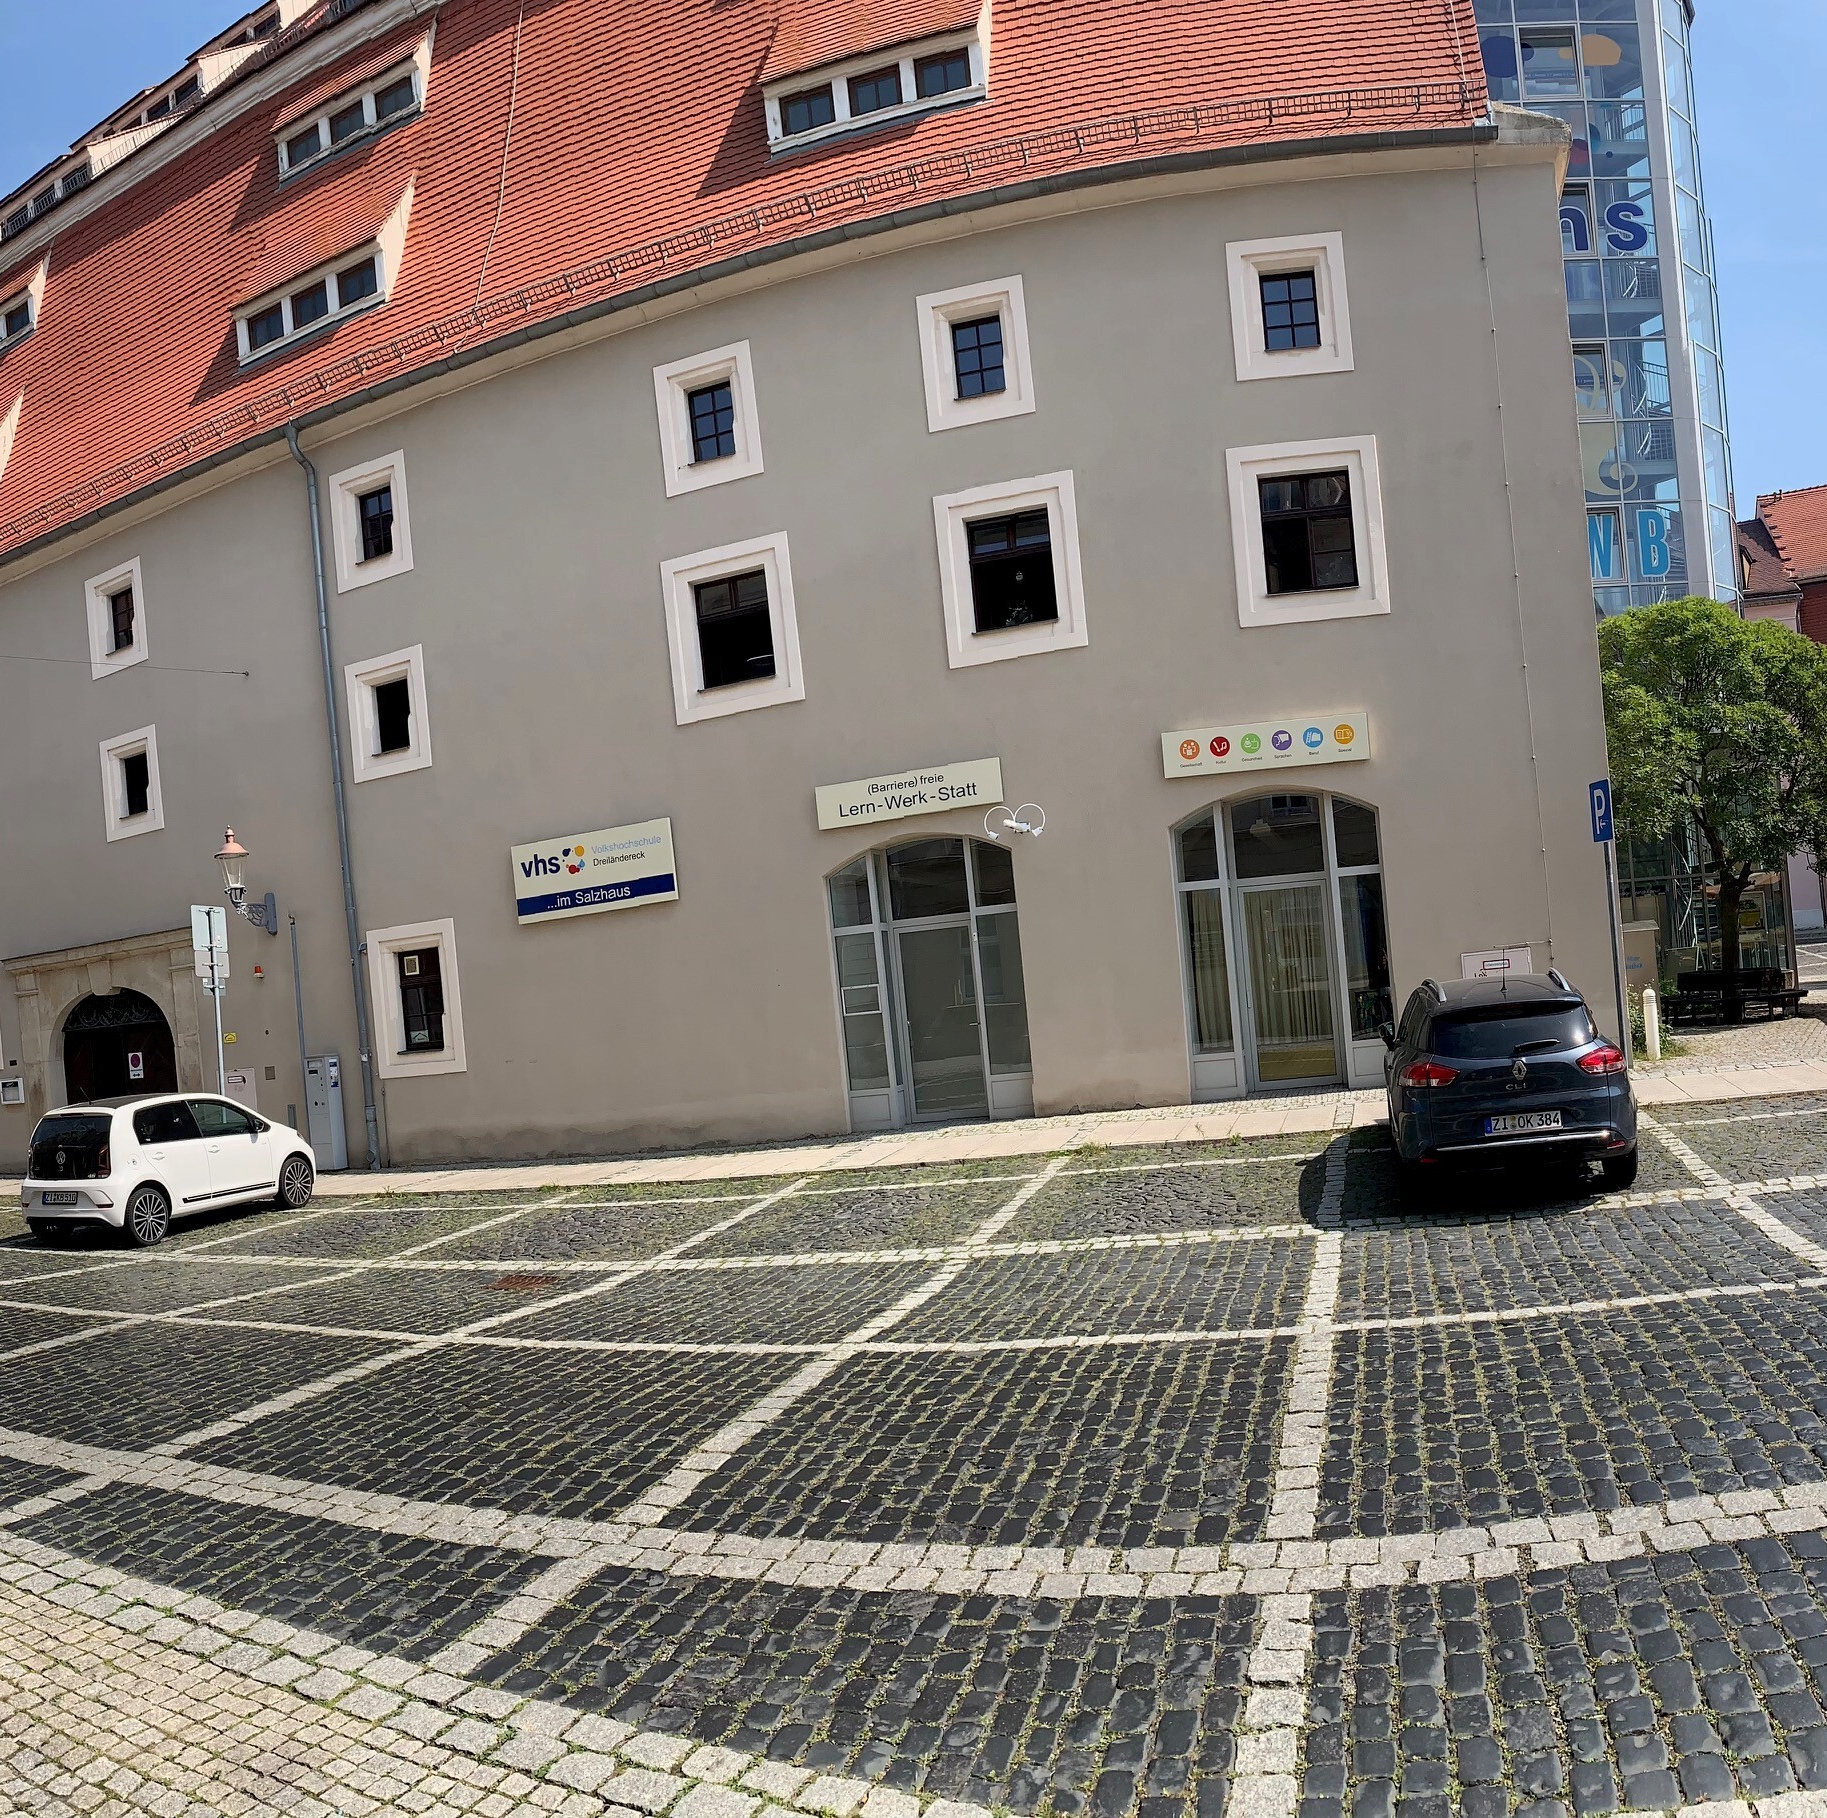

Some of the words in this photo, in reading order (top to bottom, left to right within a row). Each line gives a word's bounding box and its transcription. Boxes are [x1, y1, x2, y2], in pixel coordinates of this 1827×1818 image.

[867, 776, 918, 796] (Barriere)
[920, 773, 945, 785] freie
[1593, 788, 1606, 835] P
[591, 835, 662, 855] Volkshochschule
[520, 854, 561, 878] vhs
[593, 851, 646, 867] Dreiländereck
[575, 886, 631, 904] Salzhaus
[1492, 1117, 1509, 1131] ZI
[1517, 1114, 1534, 1128] OK
[1537, 1112, 1561, 1127] 384
